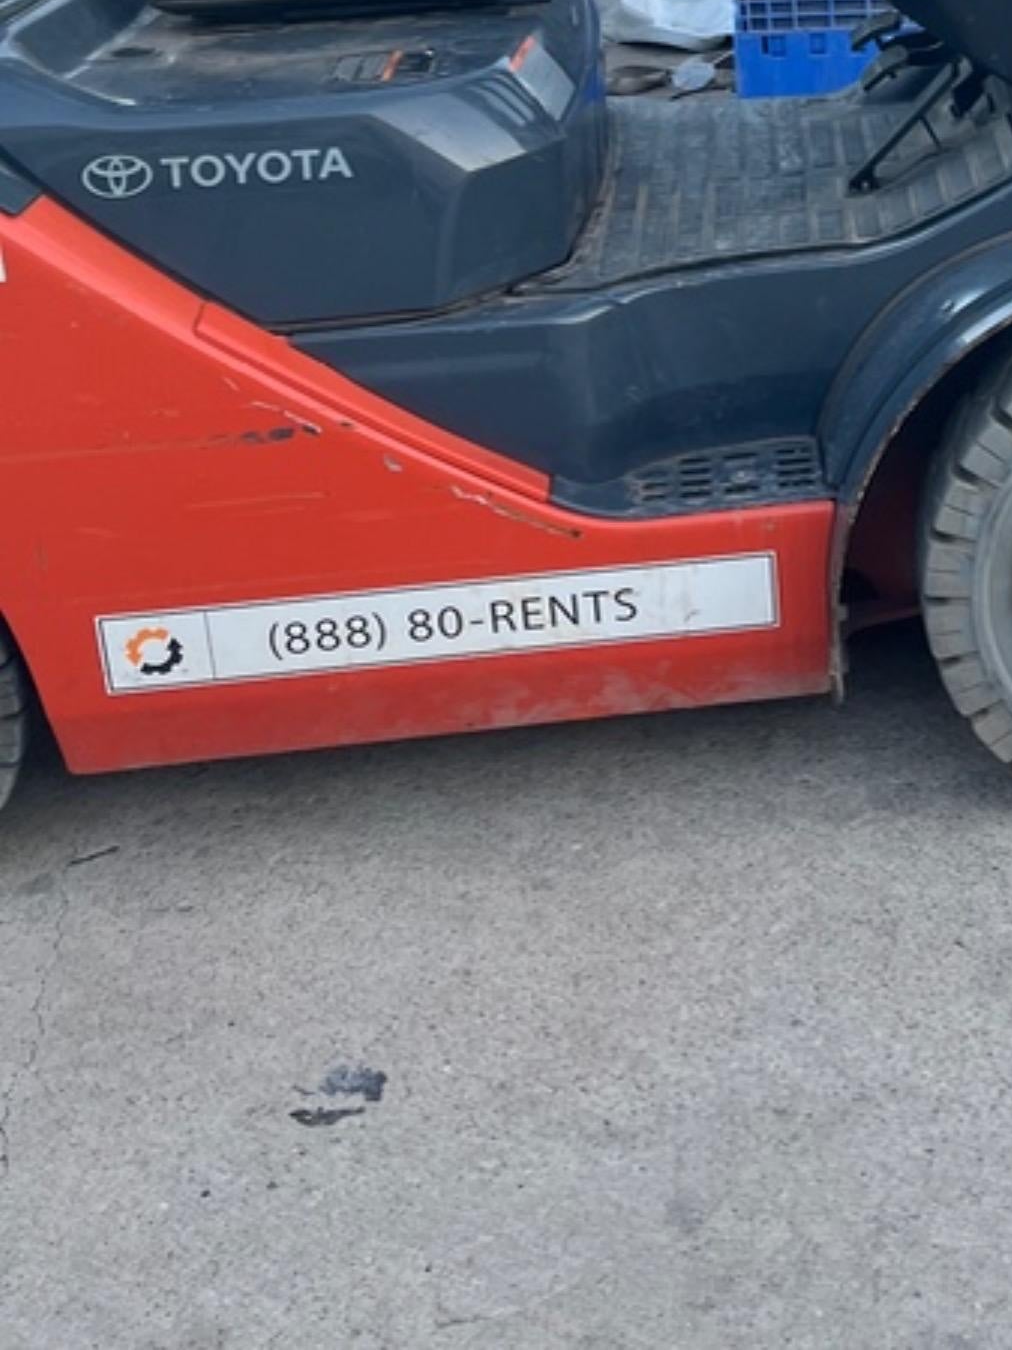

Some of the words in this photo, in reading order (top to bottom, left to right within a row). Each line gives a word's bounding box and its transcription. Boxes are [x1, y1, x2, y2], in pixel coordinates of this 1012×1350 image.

[160, 147, 353, 188] TOYOTA
[267, 612, 388, 660] (888)
[408, 587, 639, 643] 80-RENTS
